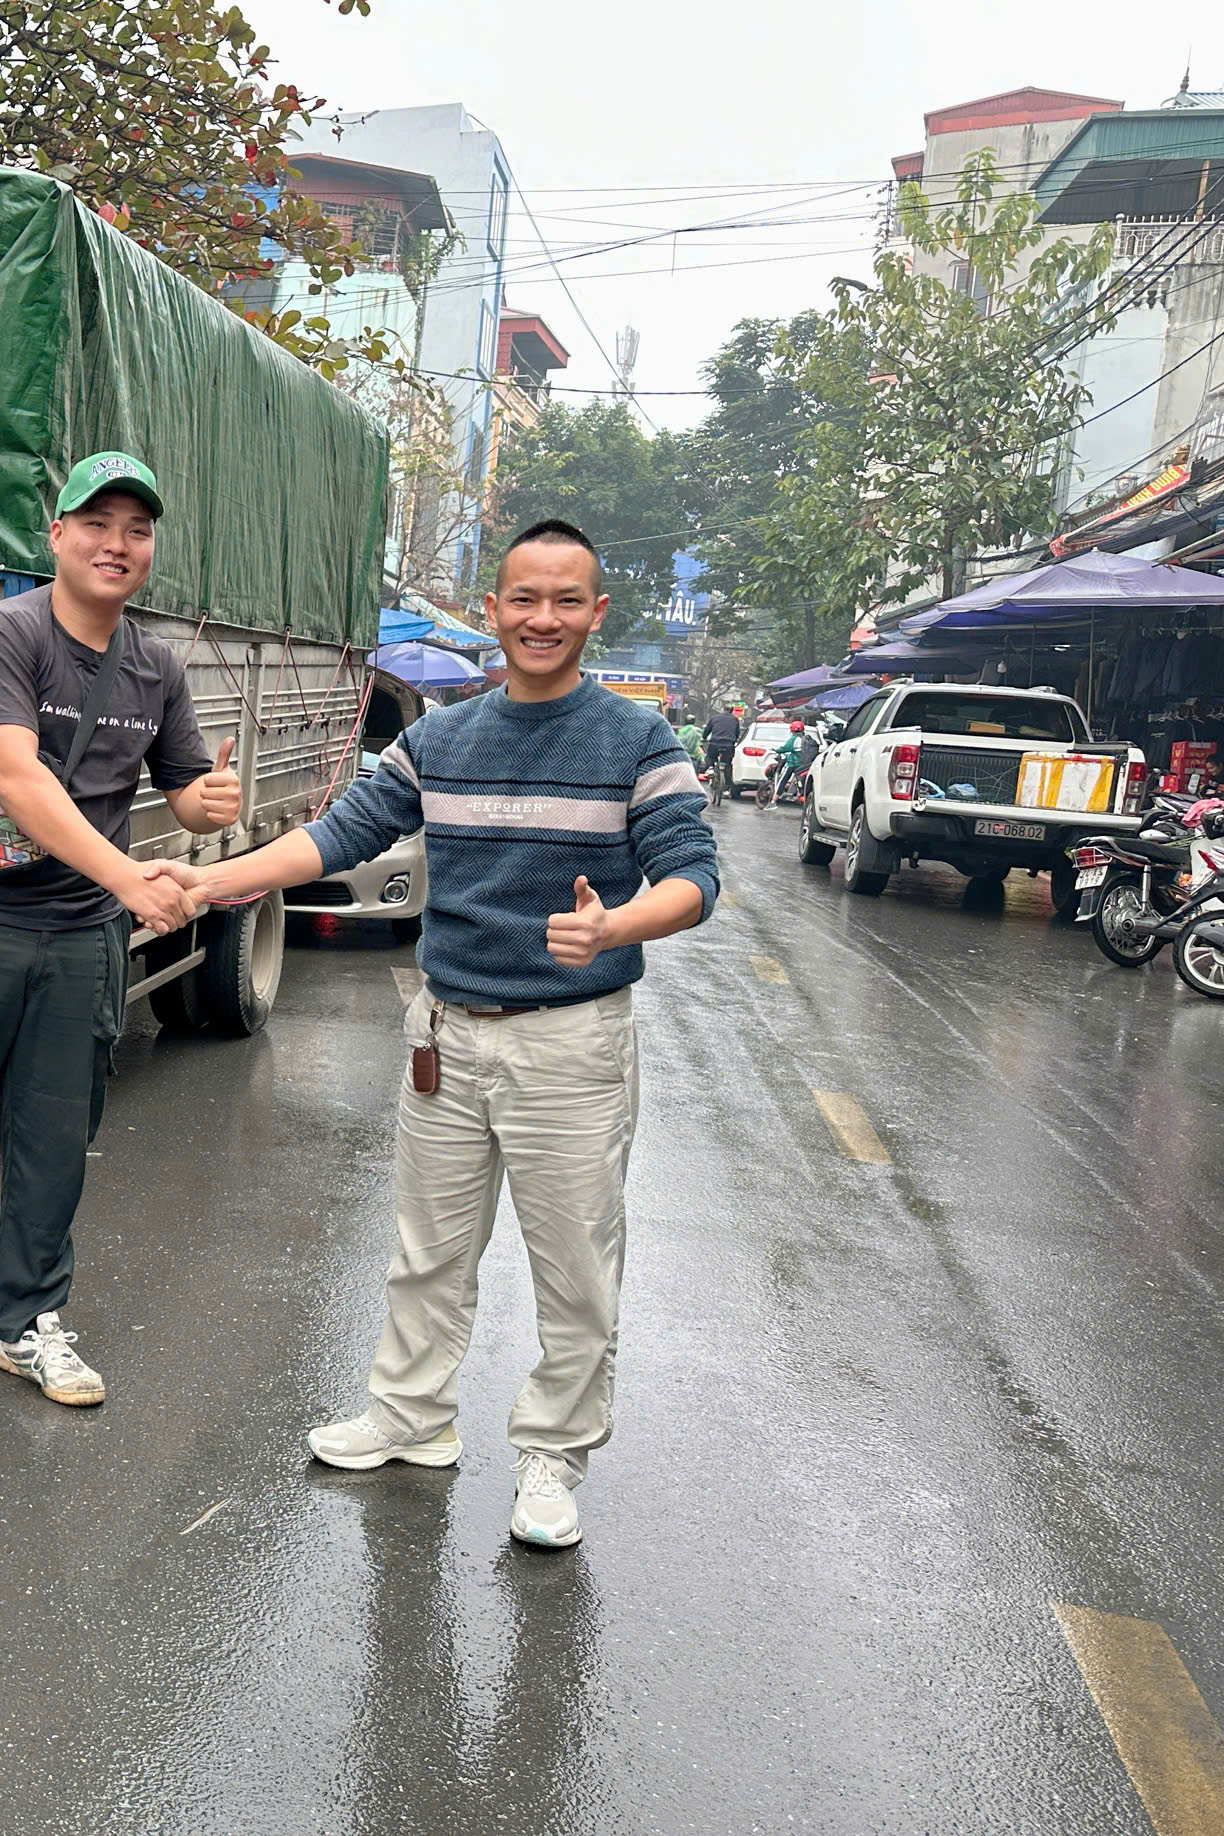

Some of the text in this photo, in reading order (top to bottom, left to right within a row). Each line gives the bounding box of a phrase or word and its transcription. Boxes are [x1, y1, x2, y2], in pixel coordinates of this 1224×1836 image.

[109, 717, 120, 727] on
[123, 719, 130, 728] a
[977, 822, 1043, 839] 21C-068.02
